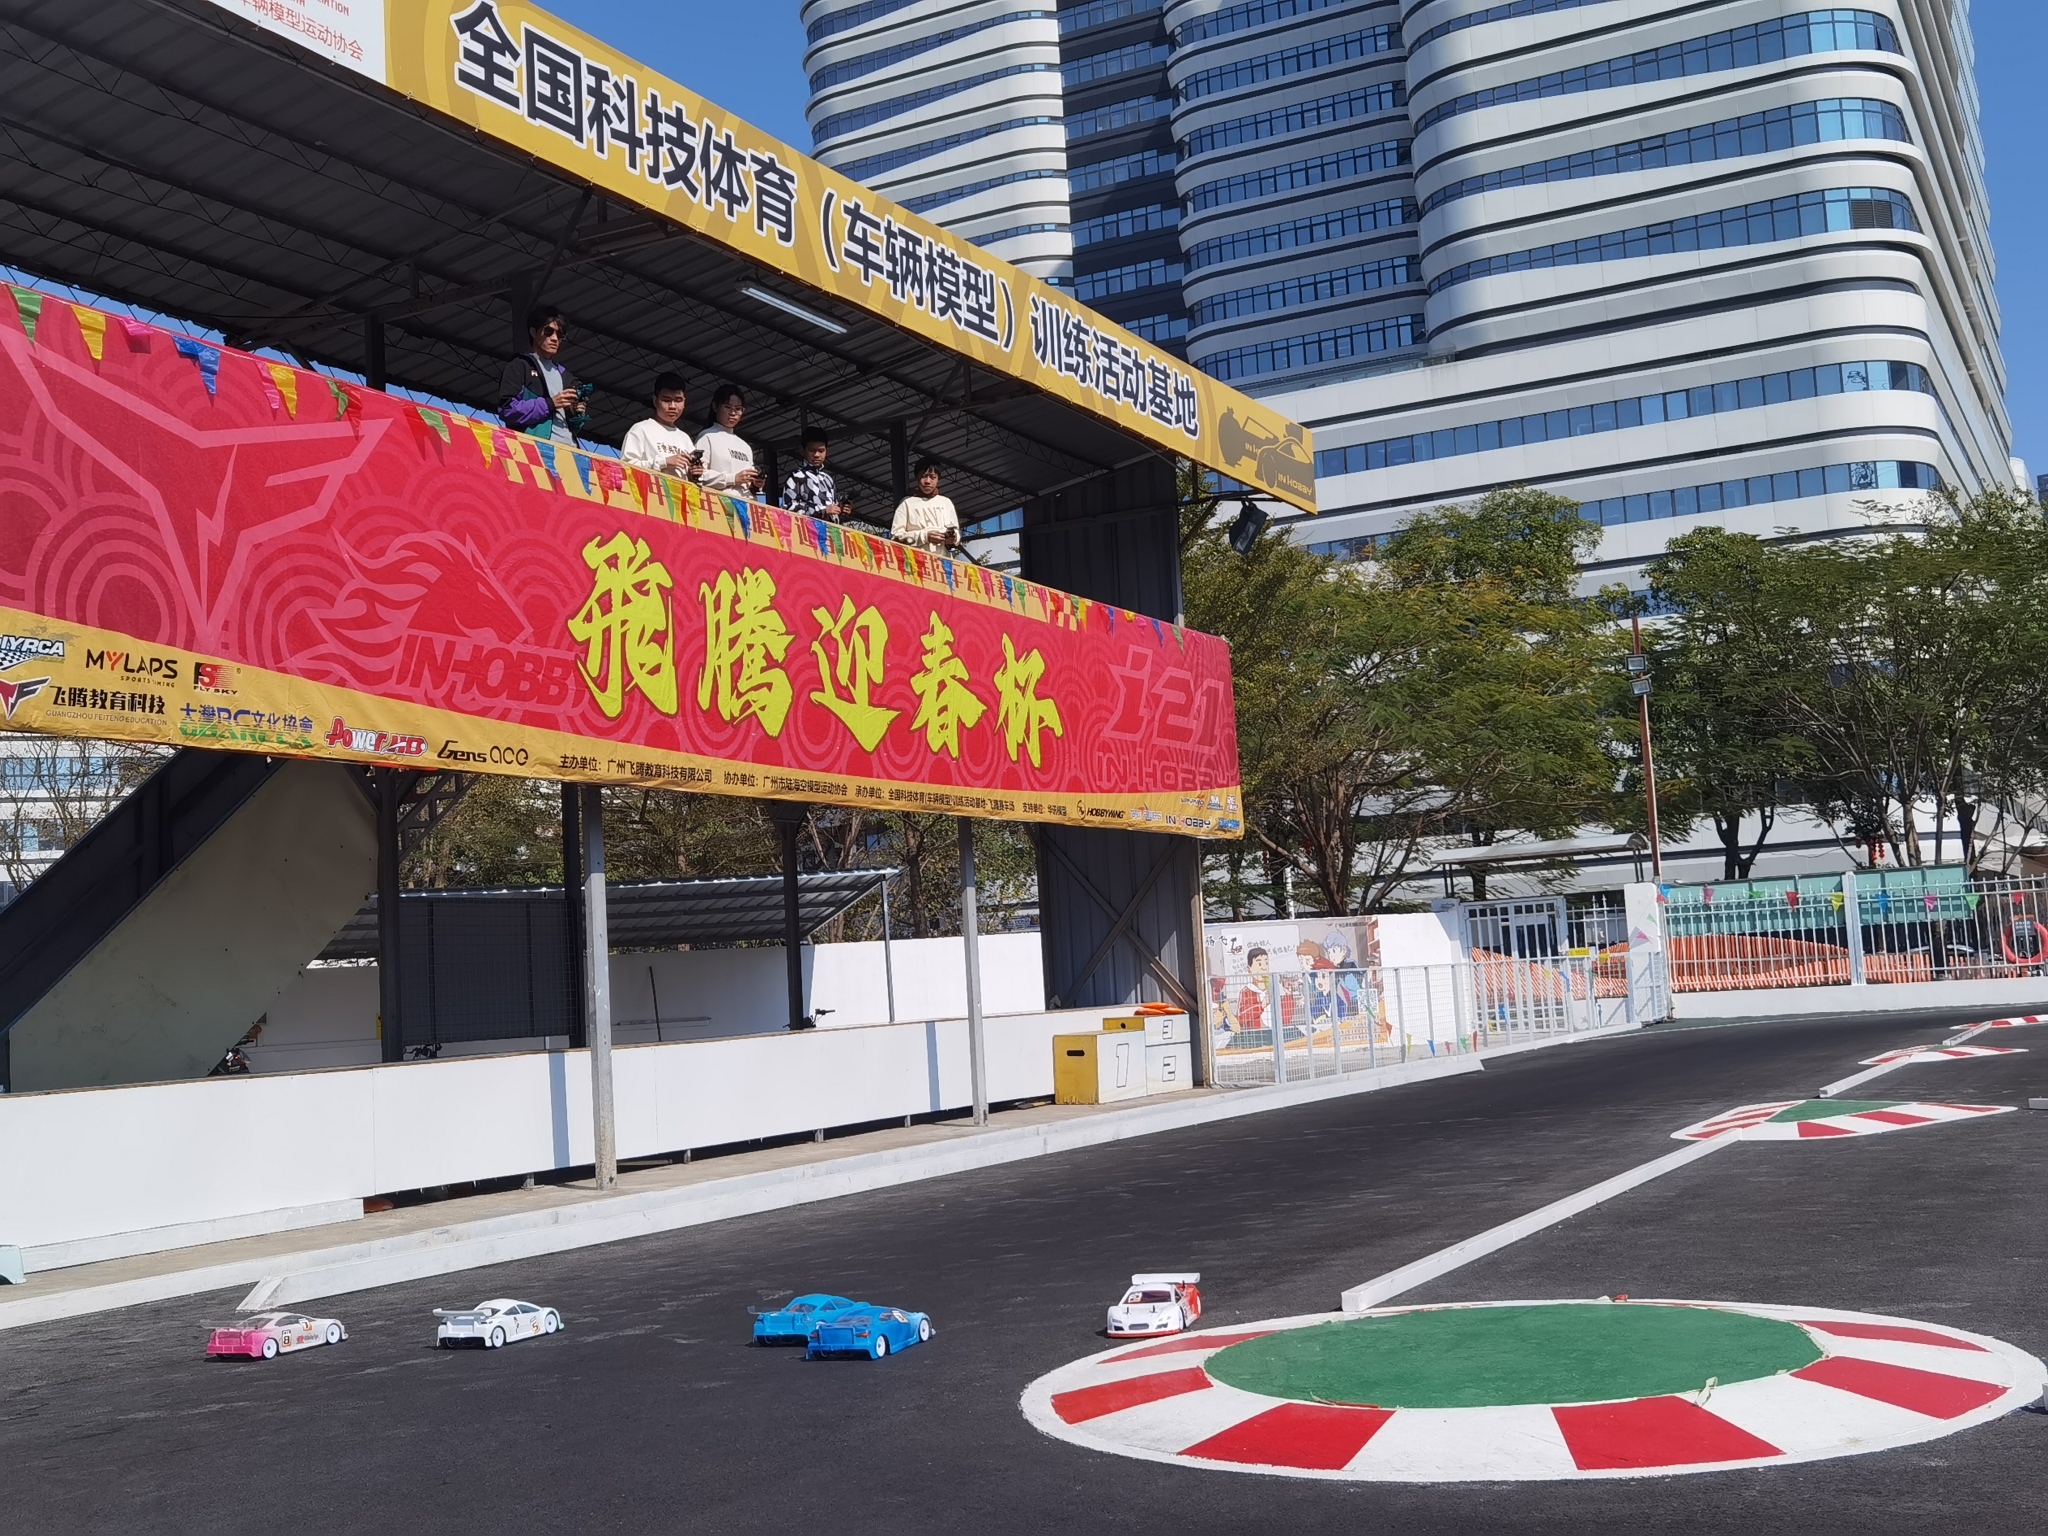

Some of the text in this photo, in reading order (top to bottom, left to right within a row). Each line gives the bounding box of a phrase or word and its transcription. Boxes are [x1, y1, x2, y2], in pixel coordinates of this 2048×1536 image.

[86, 648, 178, 680] MYLAPS
[49, 685, 166, 715] 飞腾教育科技
[437, 740, 529, 766] Gens ace
[1086, 807, 1125, 819] HOBBYWING
[1162, 1019, 1173, 1040] 3
[1116, 1042, 1130, 1088] 1
[1162, 1055, 1177, 1082] 2
